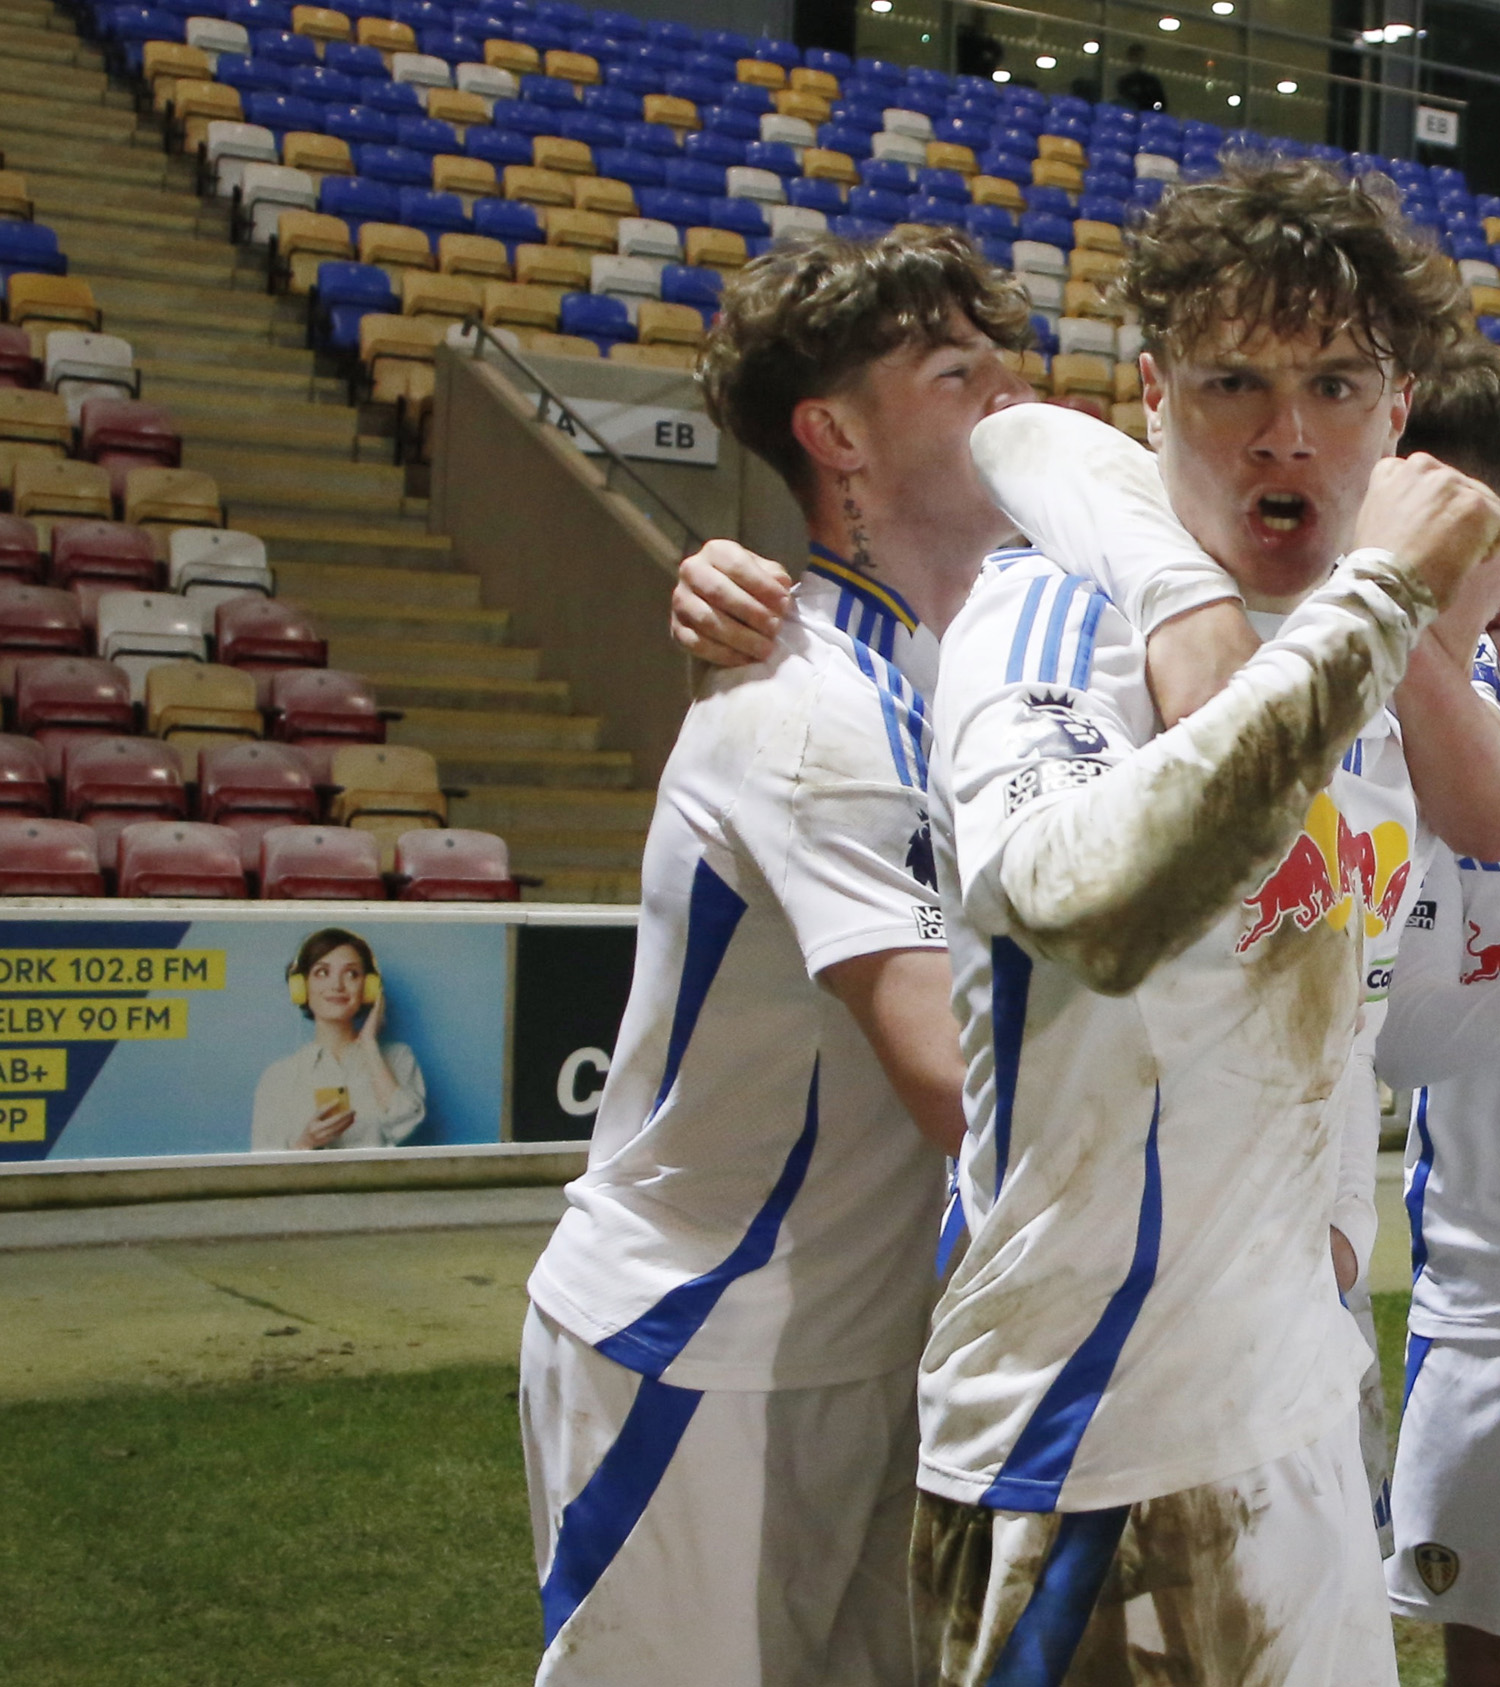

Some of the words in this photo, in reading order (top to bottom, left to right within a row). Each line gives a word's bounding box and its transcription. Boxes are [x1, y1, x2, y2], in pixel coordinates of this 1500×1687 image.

[655, 421, 695, 448] EB
[912, 906, 944, 923] No
[69, 957, 154, 983] 102.8
[164, 957, 207, 982] FM
[78, 1006, 117, 1032] 90
[127, 1006, 170, 1031] FM
